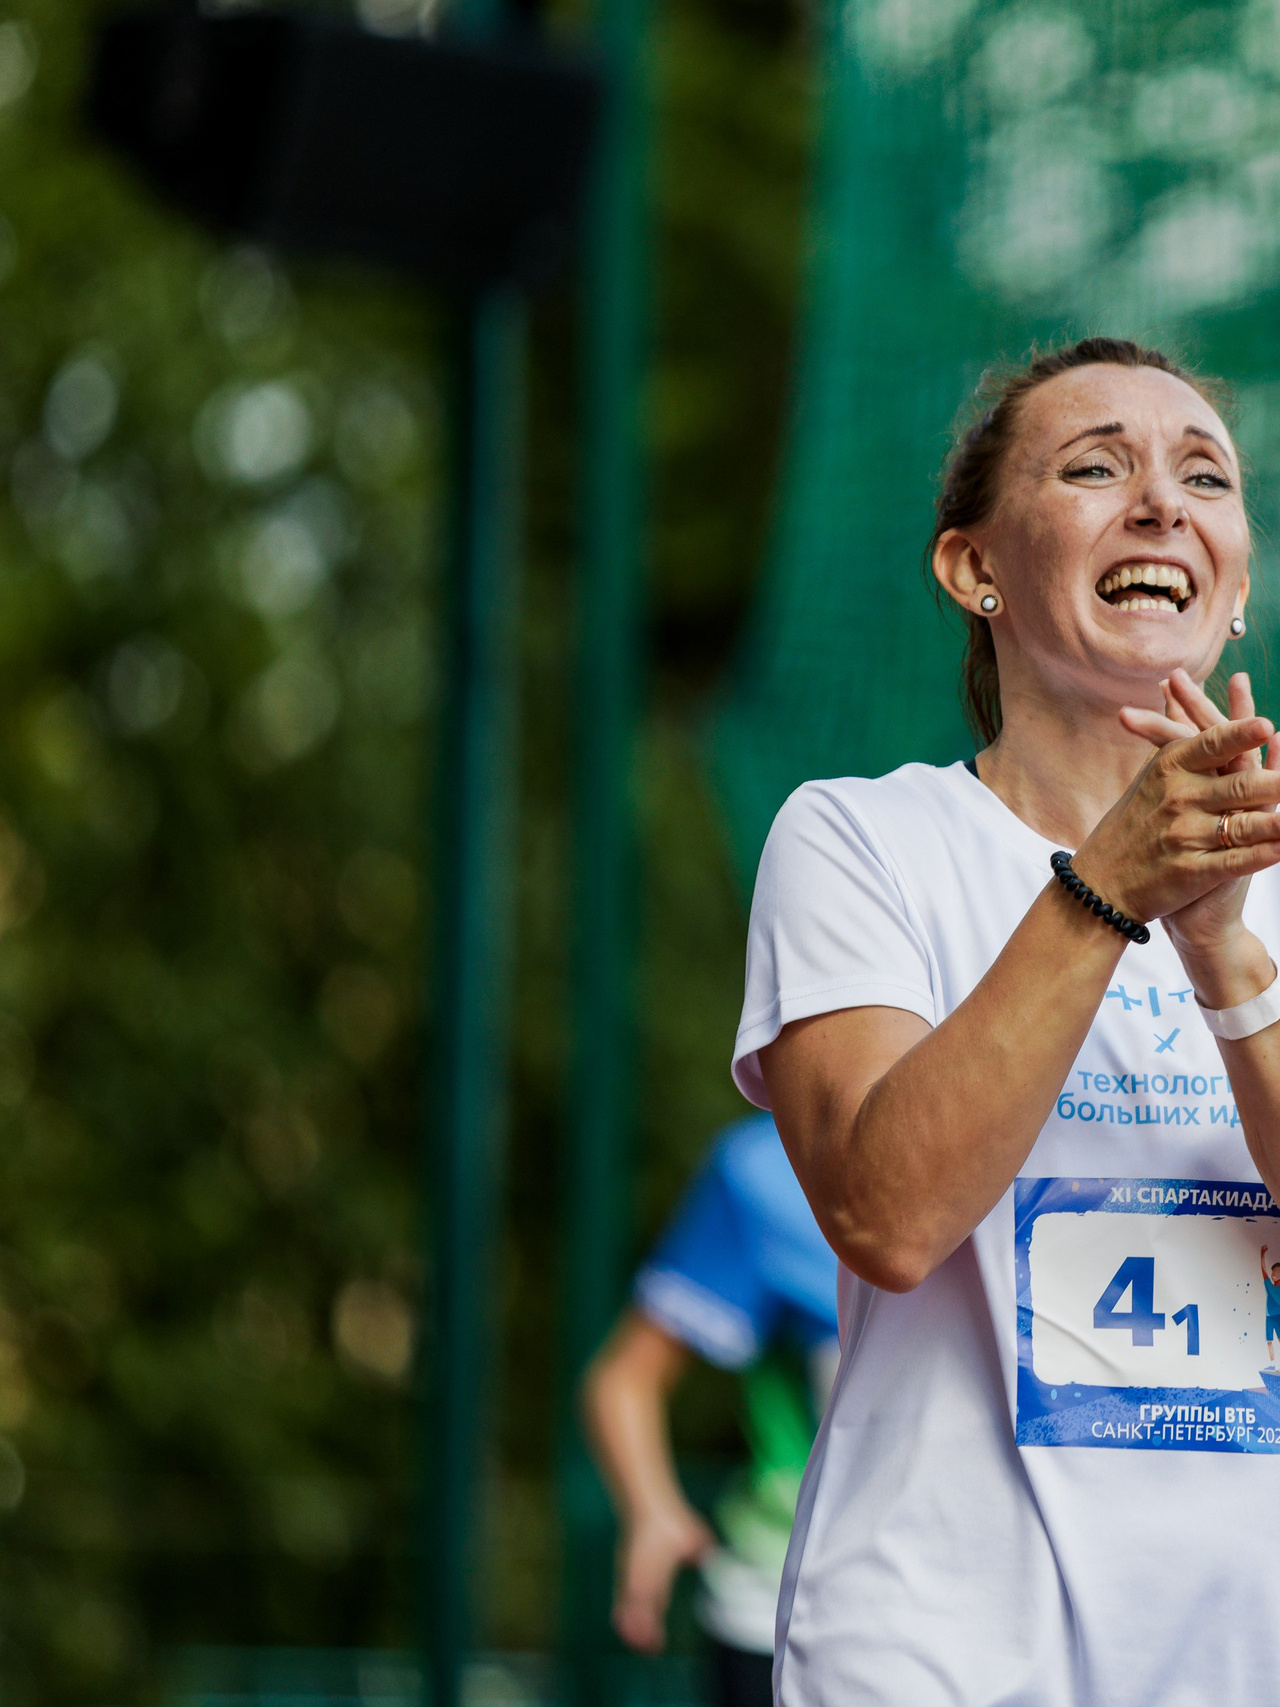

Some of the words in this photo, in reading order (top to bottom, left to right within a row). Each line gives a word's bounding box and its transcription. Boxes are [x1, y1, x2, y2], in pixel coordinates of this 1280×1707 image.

[1057, 1092, 1201, 1126] больших
[1139, 1404, 1221, 1423] ГРУППЫ
[1224, 1405, 1256, 1424] ВТБ
[1091, 1421, 1254, 1443] САНКТ-ПЕТЕРБУРГ
